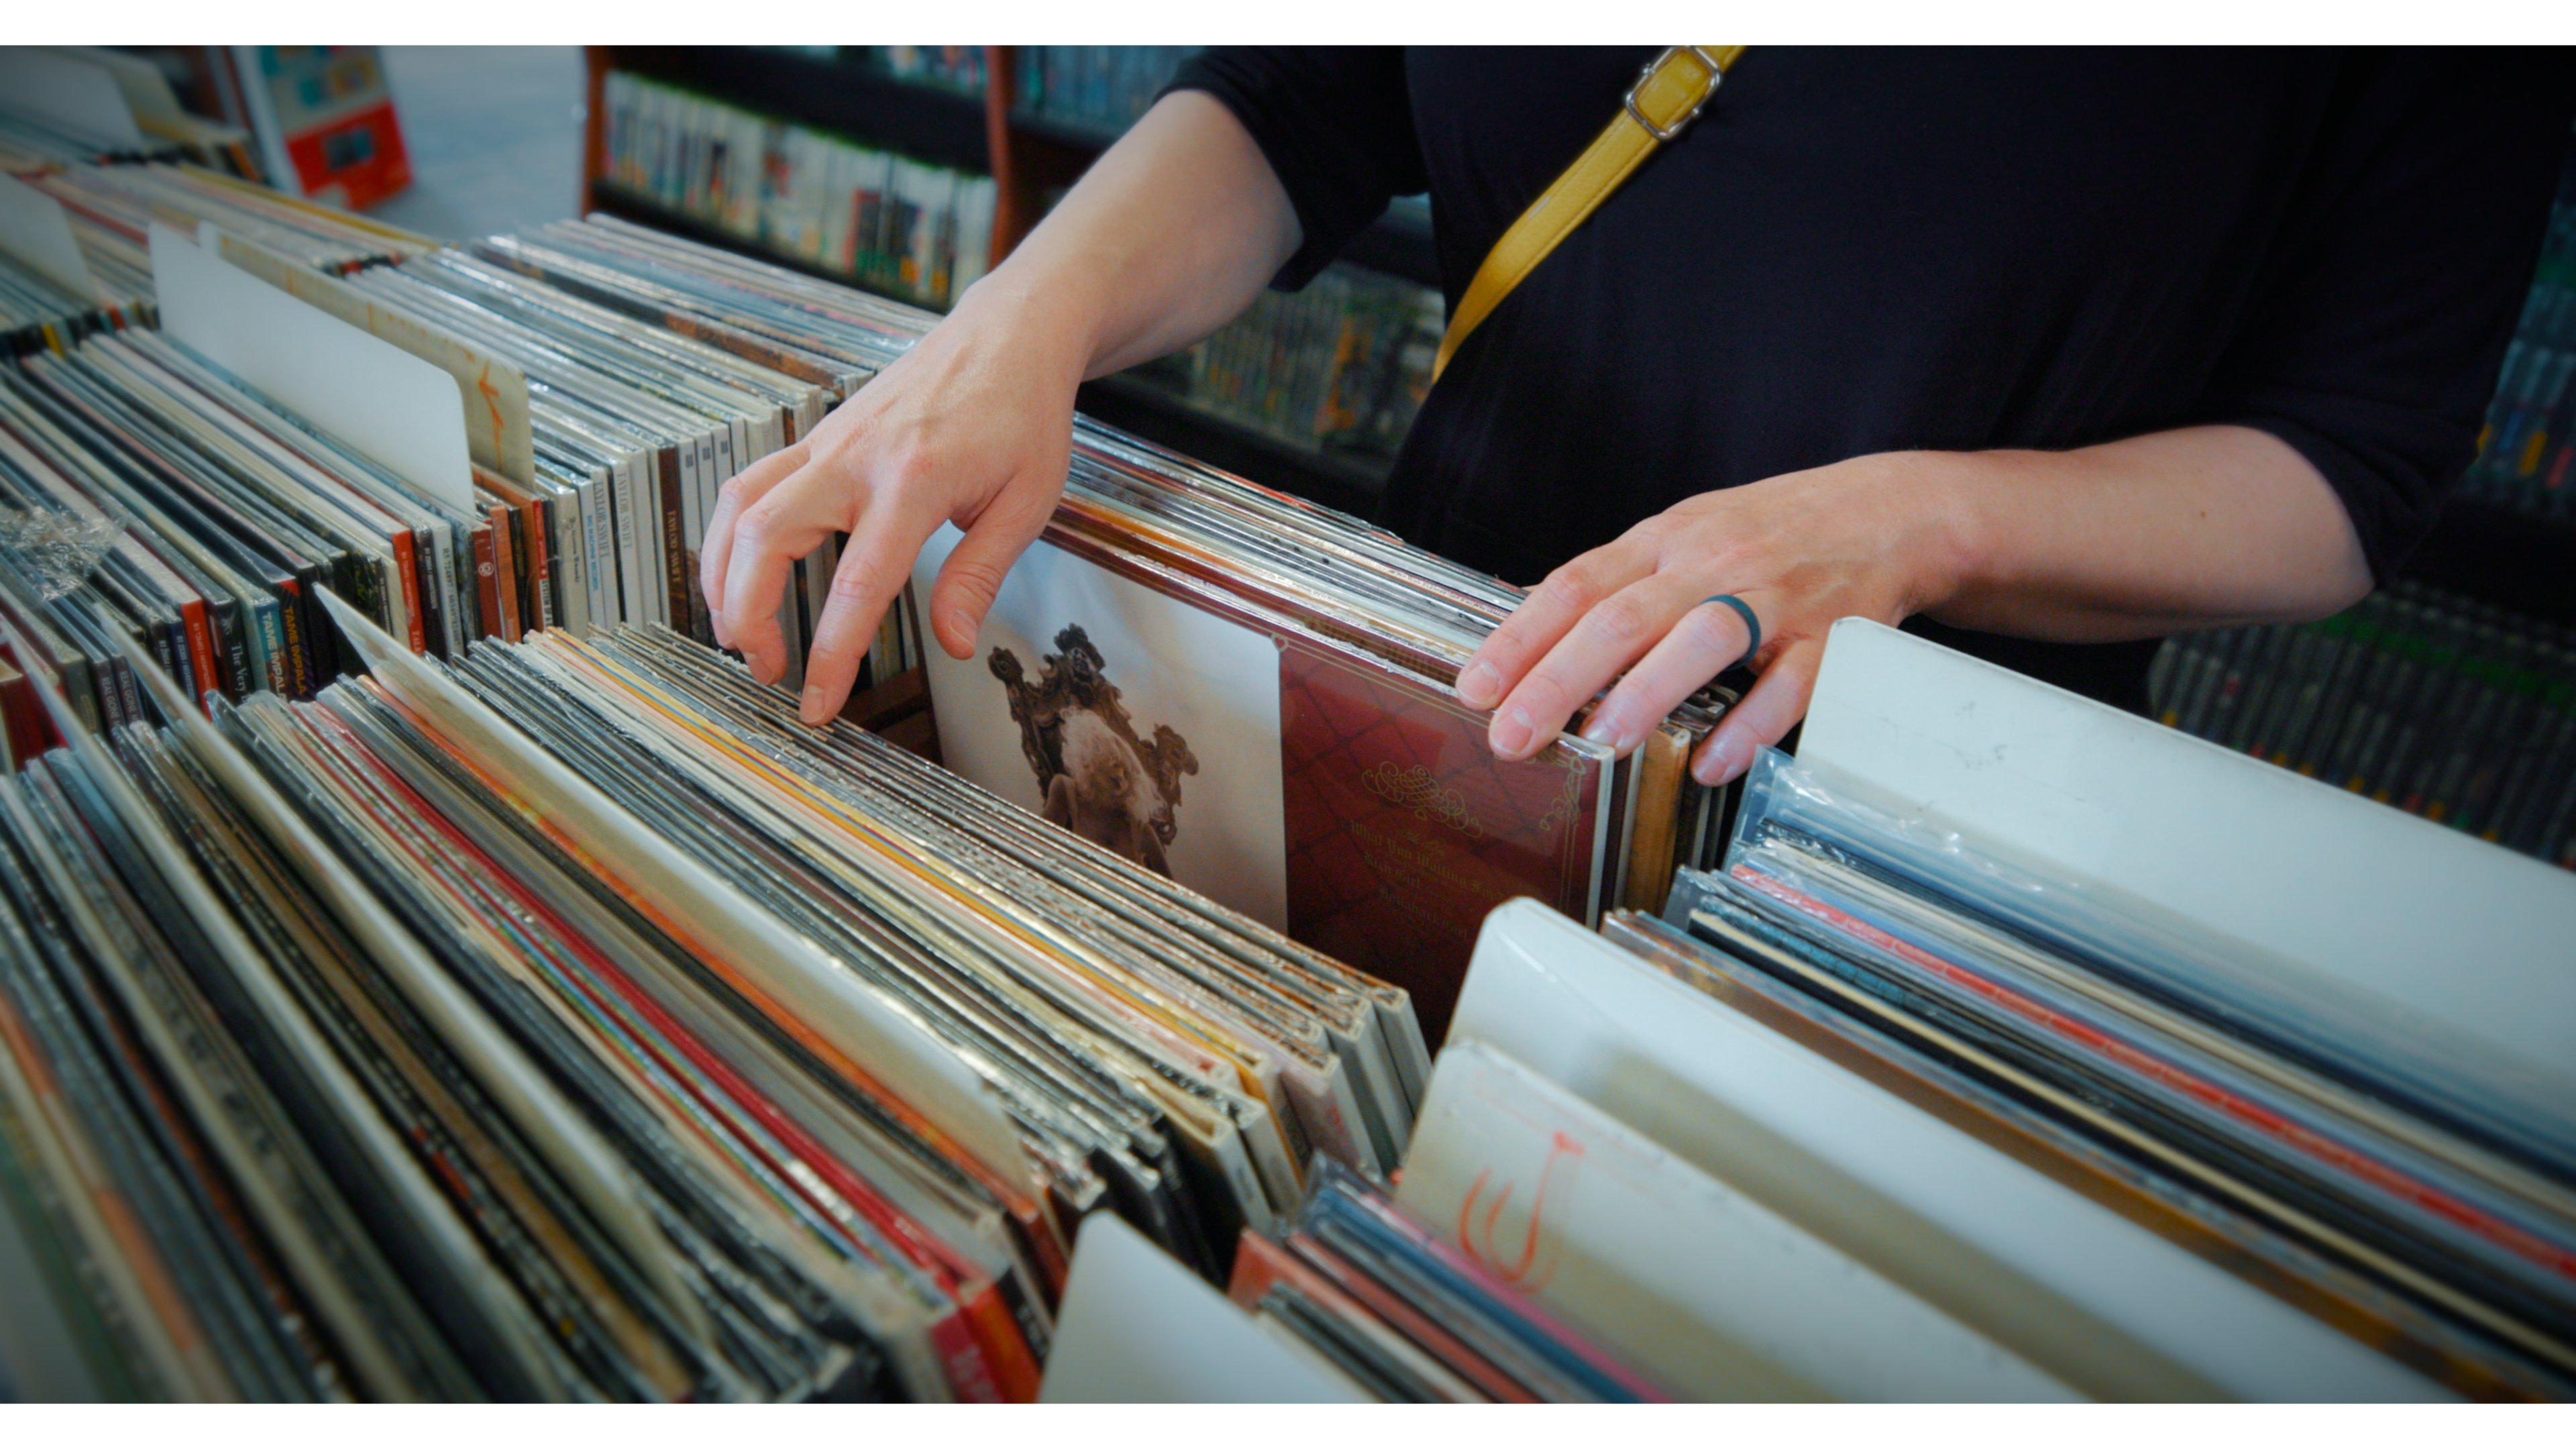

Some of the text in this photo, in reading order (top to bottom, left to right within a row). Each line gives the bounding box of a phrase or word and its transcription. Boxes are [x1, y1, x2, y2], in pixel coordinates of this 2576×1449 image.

[594, 480, 611, 558] TAYLOR SWIFT
[616, 472, 633, 549] TAYLOR SWIFT
[667, 511, 682, 584] TAYLOR SWIFT
[231, 642, 243, 666] The
[262, 611, 287, 702] TAME IMPALA
[284, 605, 307, 695] TAME IMPALA
[101, 676, 112, 698] REAL
[119, 671, 130, 692] REAL
[234, 667, 248, 692] Very
[105, 696, 119, 719] GONE
[124, 690, 137, 712] GONE
[1350, 819, 1383, 847] What
[1417, 851, 1467, 890] Waiting
[1364, 850, 1392, 875] Rich
